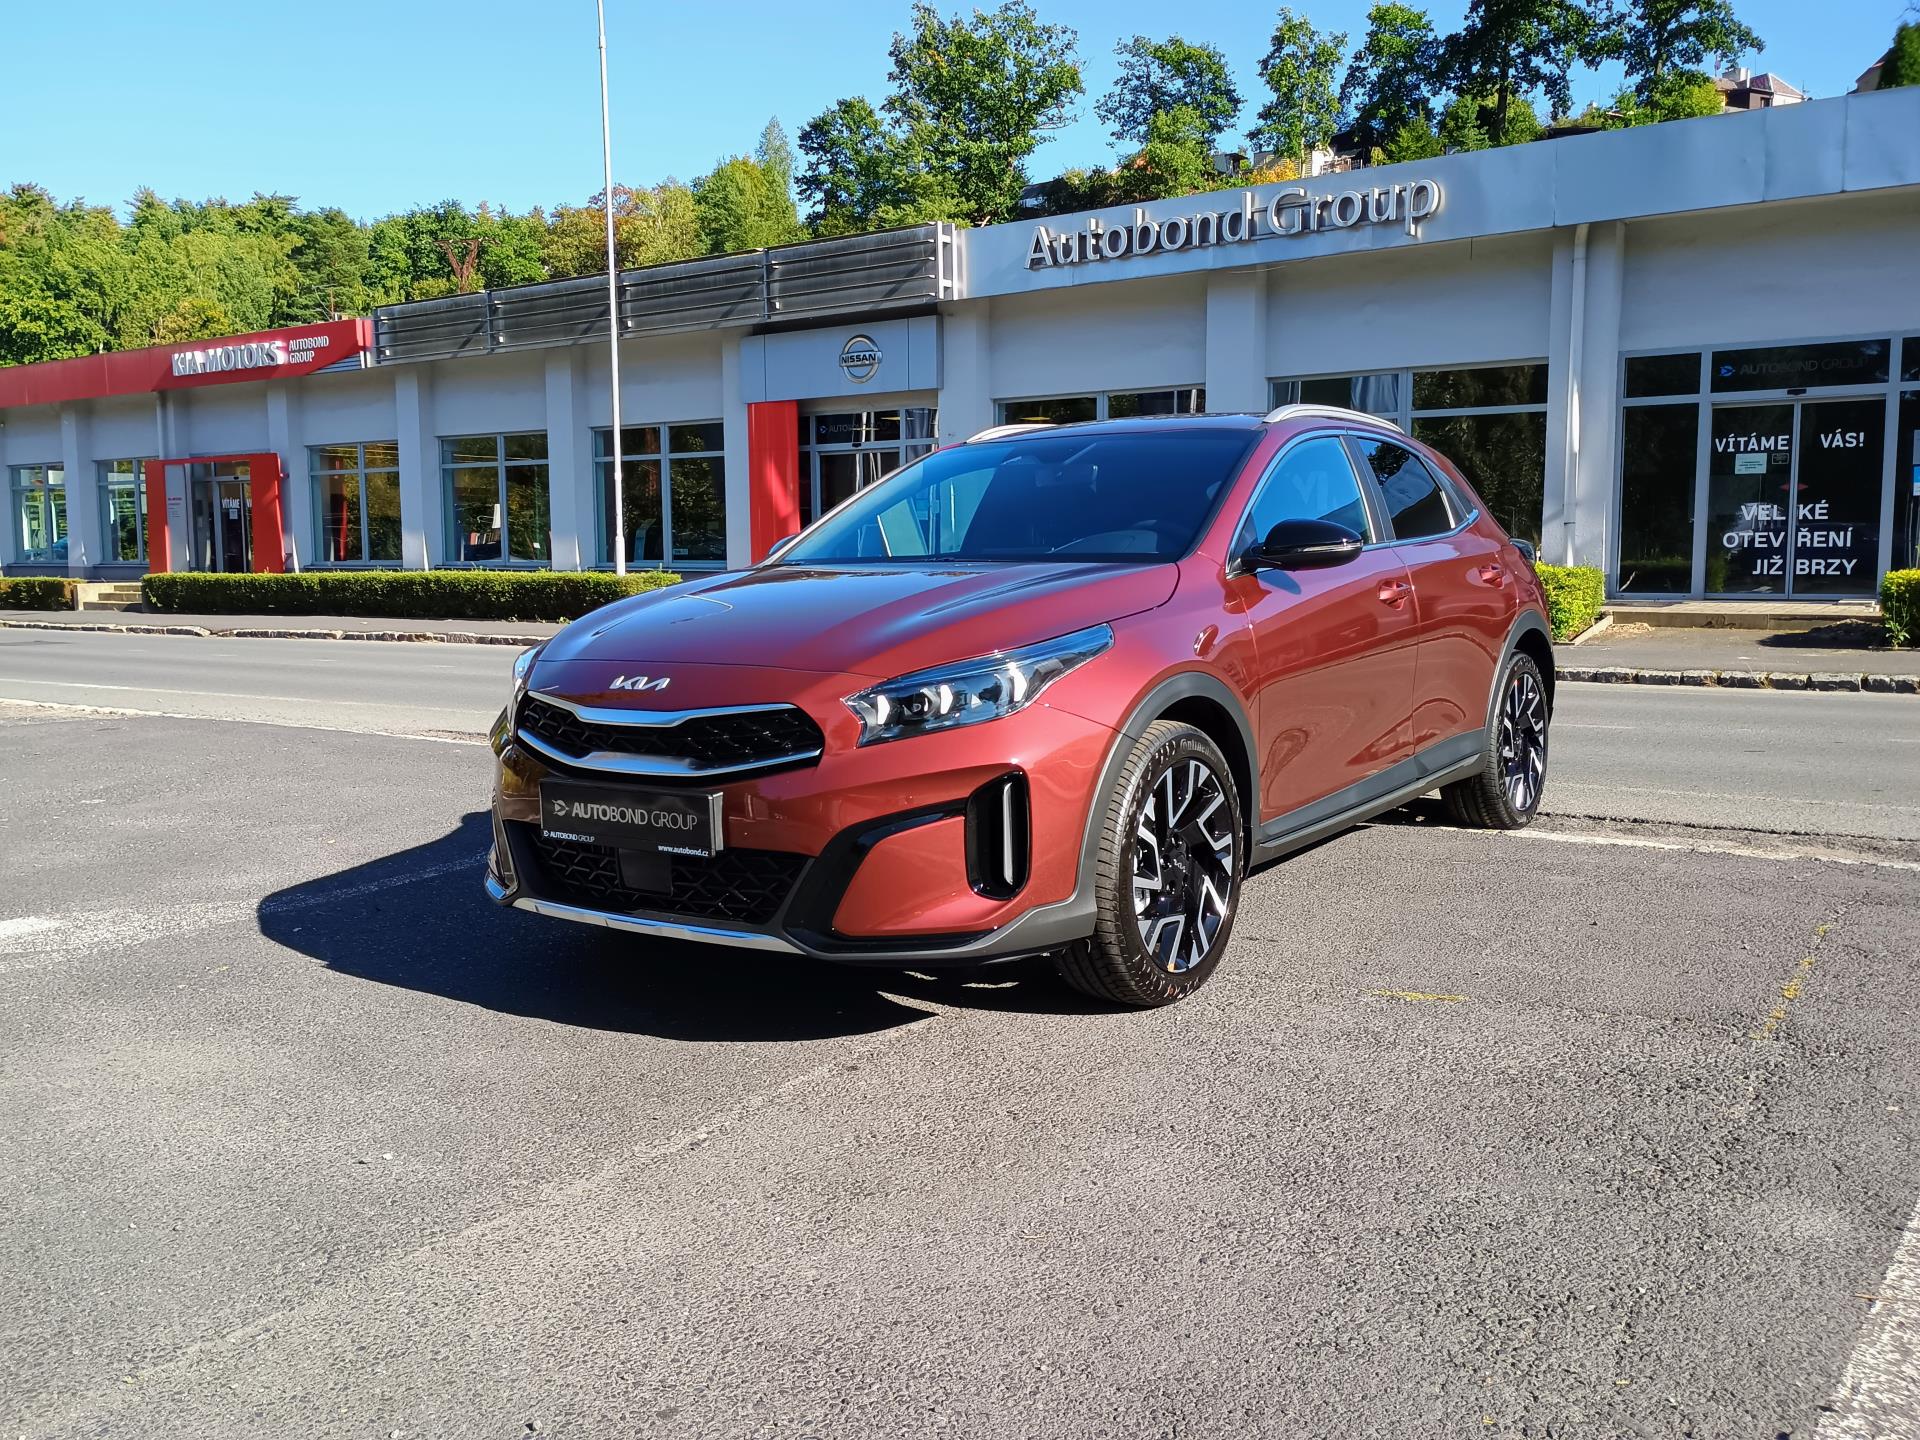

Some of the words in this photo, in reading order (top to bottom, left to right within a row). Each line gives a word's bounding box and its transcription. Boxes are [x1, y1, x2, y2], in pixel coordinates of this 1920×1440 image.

[1024, 191, 1252, 269] Autobond
[1267, 180, 1440, 236] Group
[288, 336, 329, 352] AUTOBOND
[172, 351, 204, 376] KIA
[205, 341, 281, 372] MOTORS
[289, 350, 315, 364] GROUP
[841, 353, 877, 364] NISSAN
[1715, 432, 1790, 453] VÍTÁME
[1820, 428, 1865, 448] VÁS!
[1752, 555, 1784, 575] JIŽ
[1795, 559, 1858, 575] BRZY
[609, 675, 671, 692] KIA
[572, 802, 648, 825] AUTOBOND
[651, 811, 698, 831] GROUP
[550, 832, 578, 841] AUTOBOND
[578, 834, 595, 843] GROUP
[657, 844, 709, 857] www.autobond.cz
